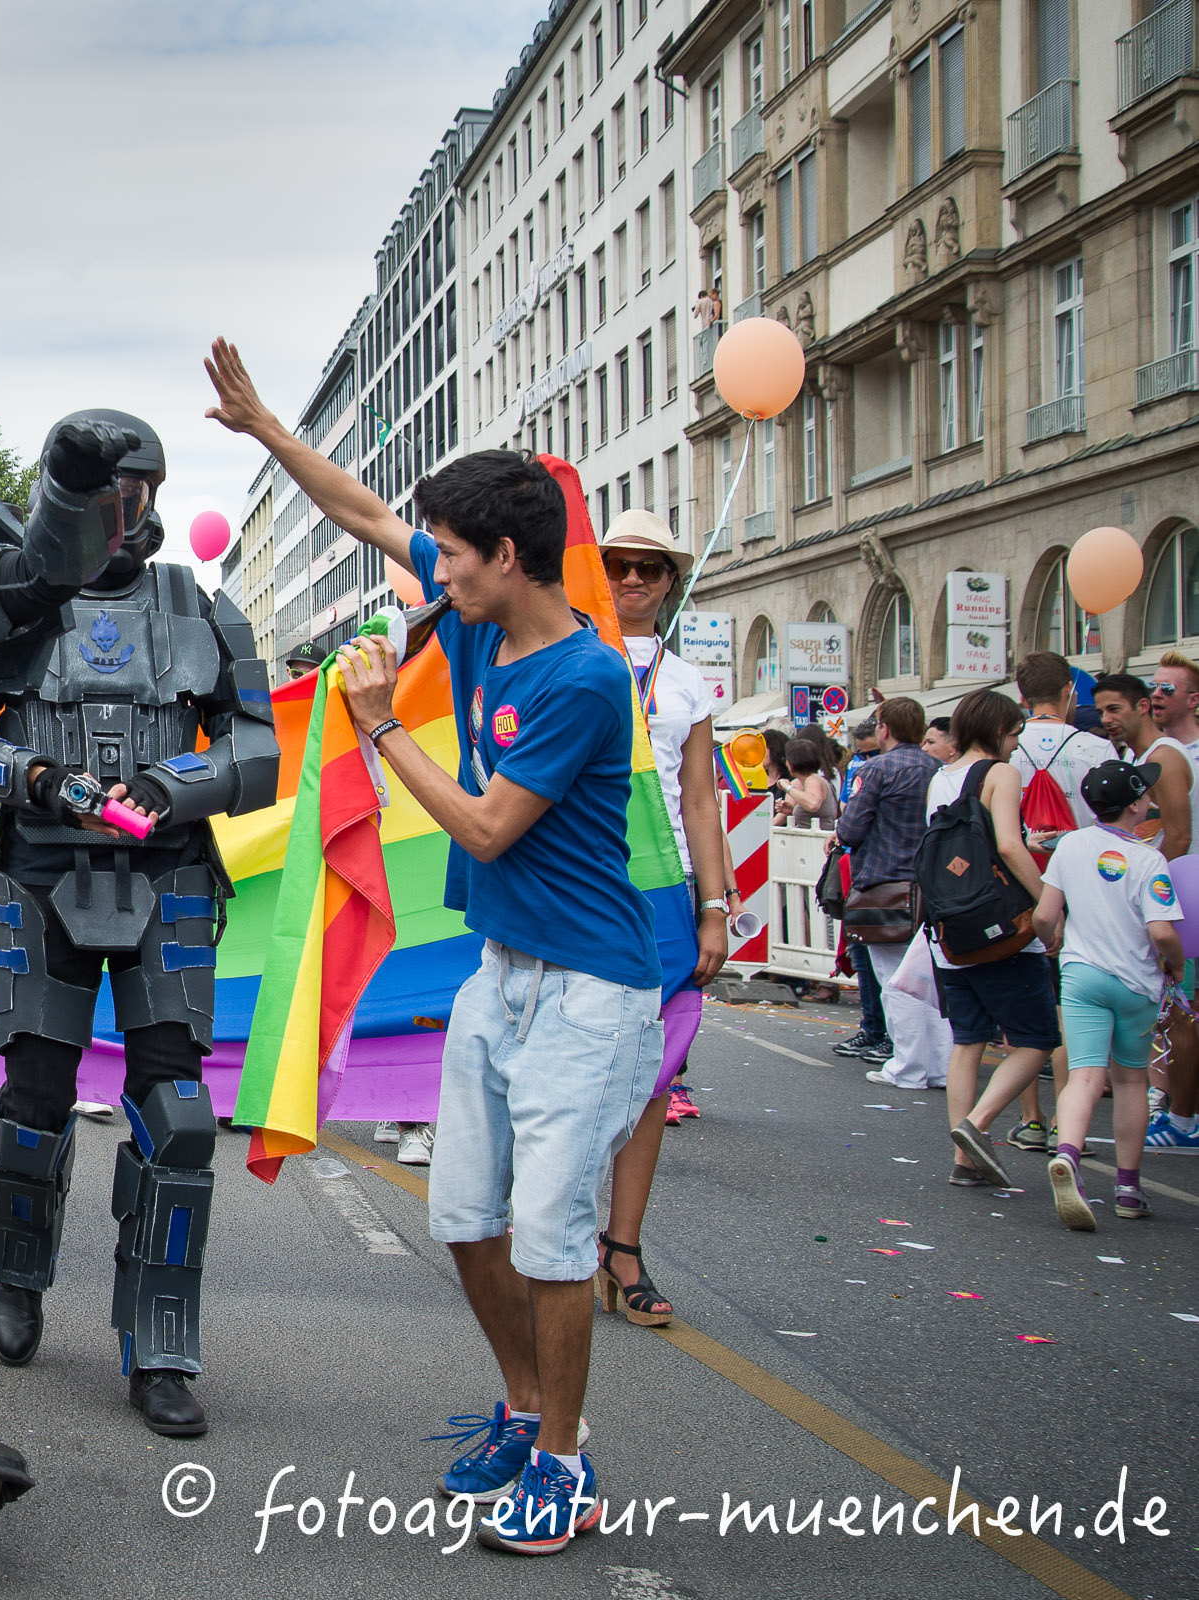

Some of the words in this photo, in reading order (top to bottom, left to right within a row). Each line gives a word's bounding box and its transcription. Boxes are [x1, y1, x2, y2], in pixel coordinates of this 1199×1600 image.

[956, 603, 1001, 614] Running
[683, 638, 730, 648] Reinigung
[790, 639, 821, 653] saga
[810, 649, 842, 665] dent
[497, 715, 513, 732] HOT
[795, 716, 808, 726] TAXI
[371, 721, 393, 739] MANGO
